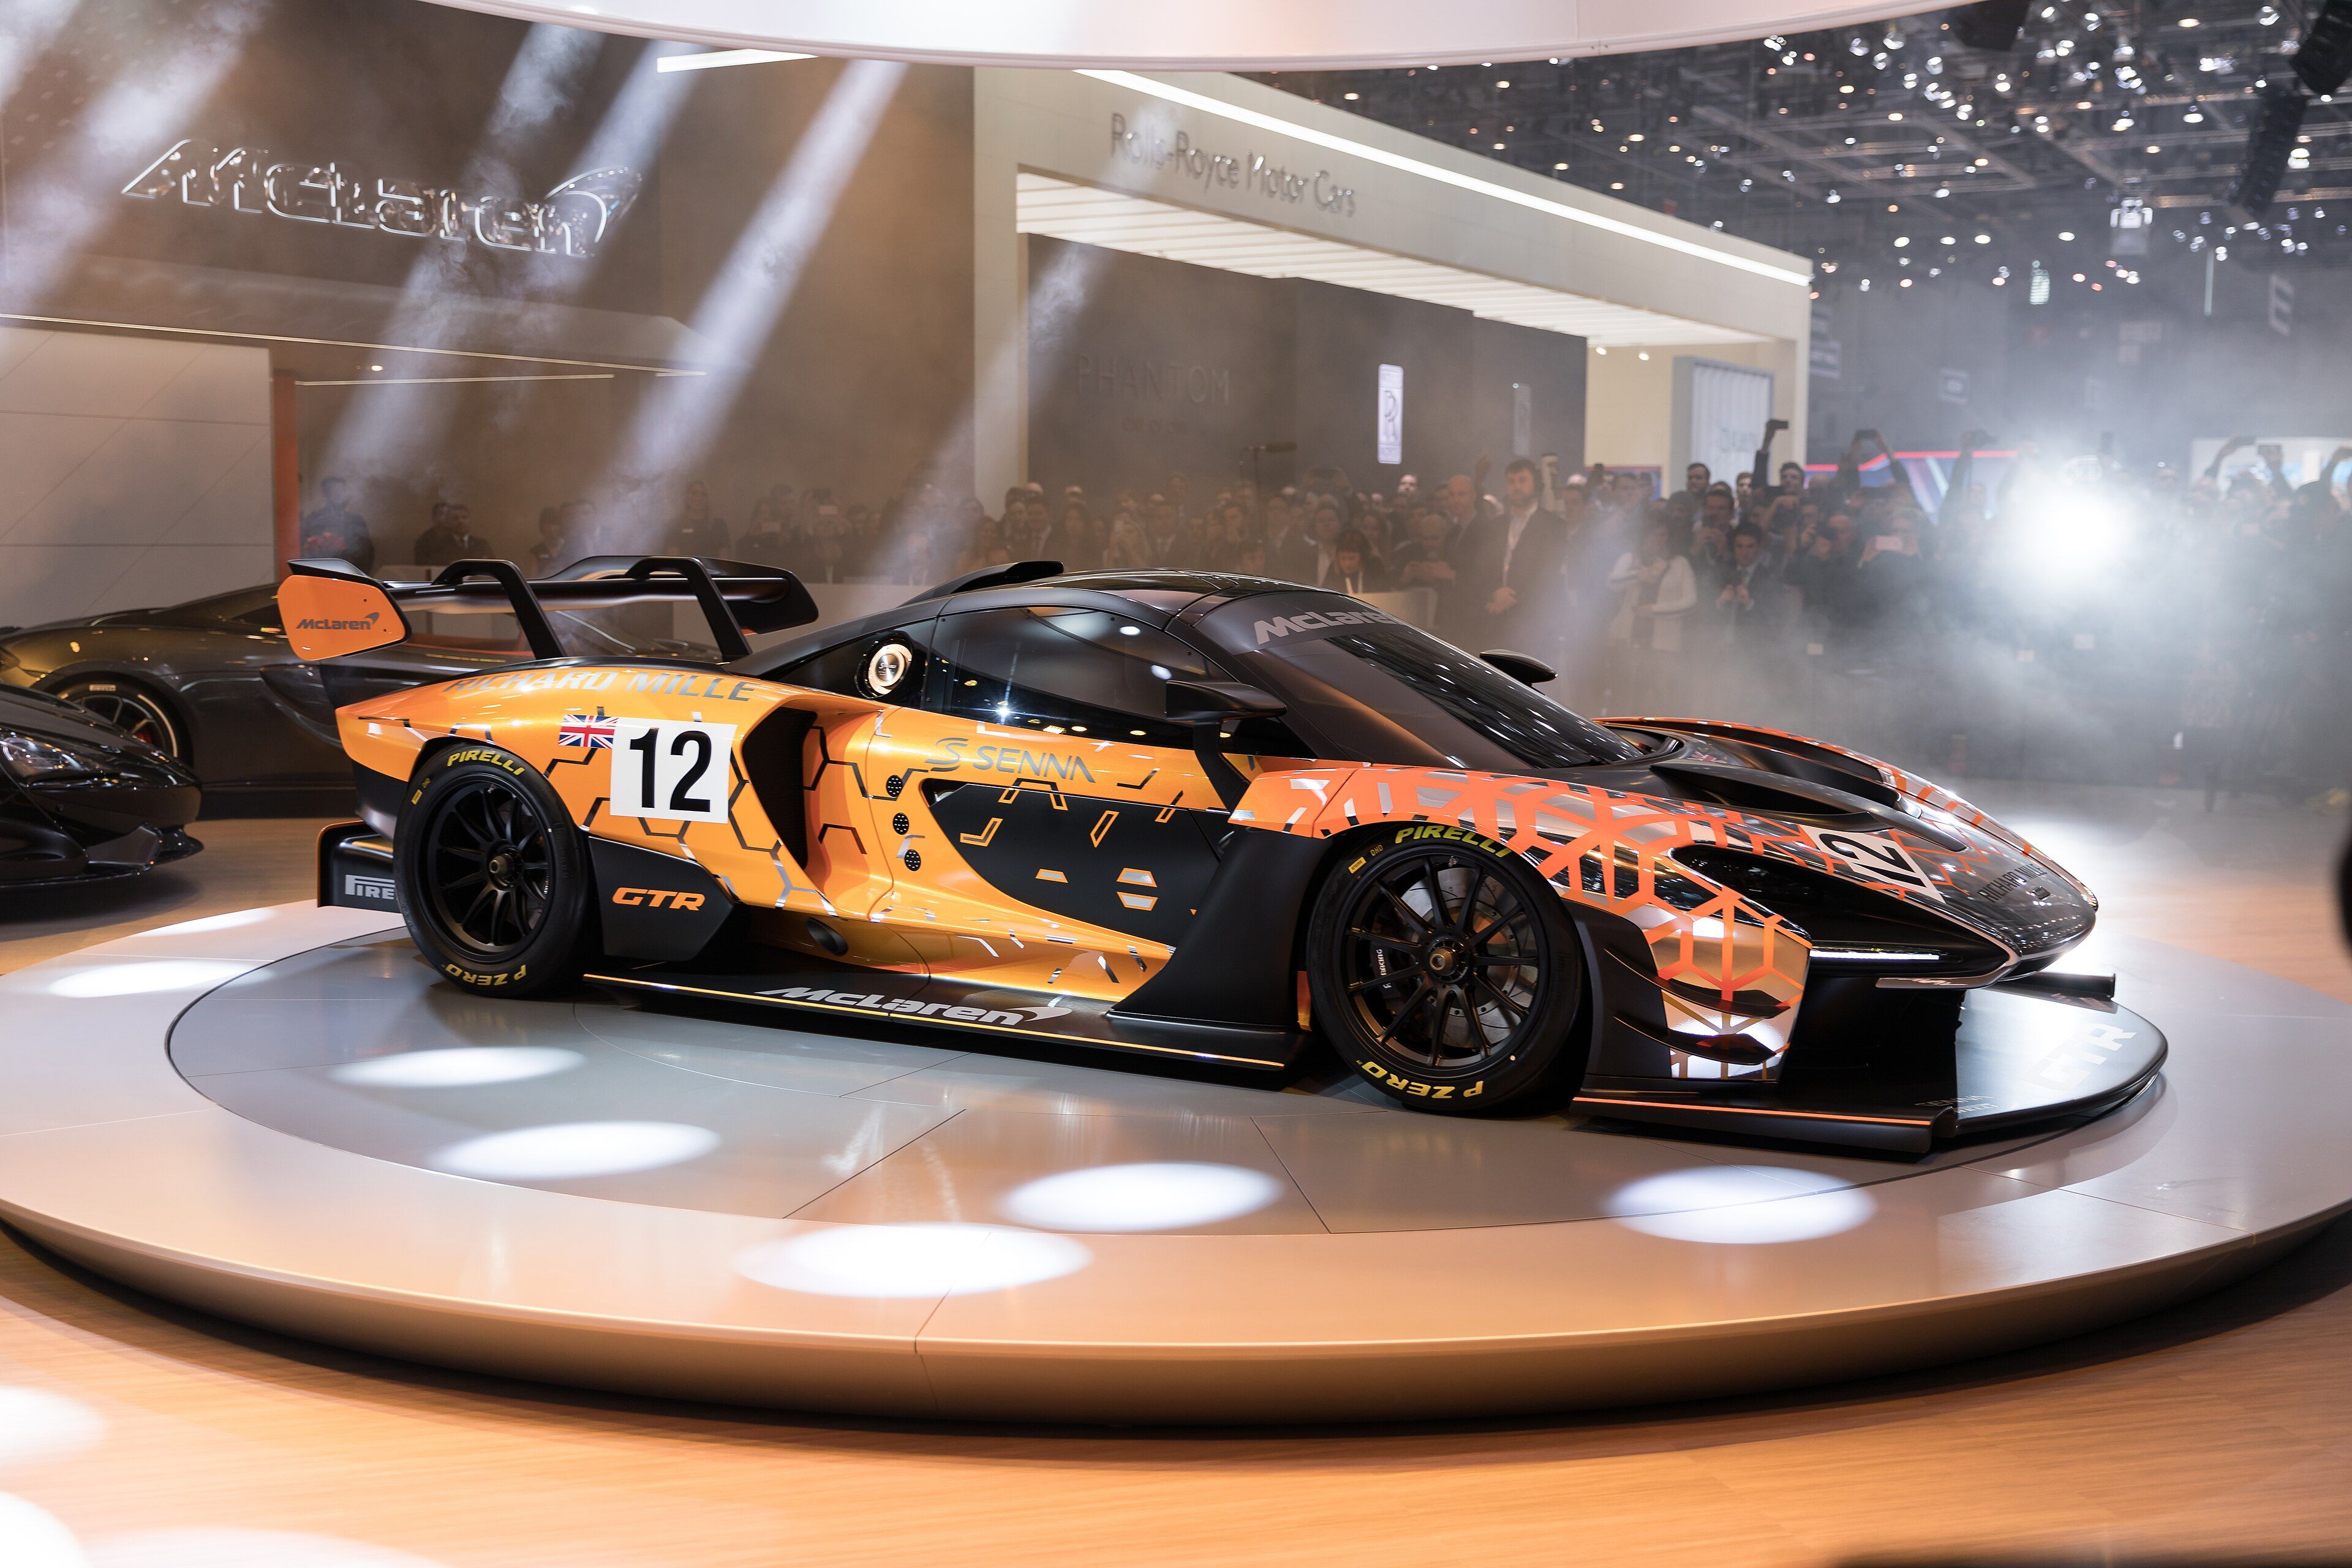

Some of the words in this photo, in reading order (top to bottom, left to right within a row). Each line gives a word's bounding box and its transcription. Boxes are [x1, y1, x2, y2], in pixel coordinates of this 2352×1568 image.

[1110, 111, 1240, 193] Rolls-Royce
[1246, 150, 1308, 203] Motor
[1314, 169, 1356, 218] Cars
[122, 138, 608, 258] McLaren
[1074, 352, 1230, 407] PHANTOM
[295, 618, 371, 630] McLaren
[1253, 611, 1399, 645] McLare
[442, 670, 614, 693] RICHARD
[625, 672, 756, 702] MILLE
[447, 749, 526, 775] PIRELLI
[628, 728, 712, 813] 12
[973, 745, 1096, 783] SENNA
[1395, 824, 1514, 858] PIRELLI
[1819, 833, 1928, 888] 12
[344, 874, 396, 900] PIRE
[612, 886, 706, 911] GTR
[1976, 871, 2028, 903] RICHARD
[2014, 863, 2048, 880] MILLE
[445, 963, 508, 986] ZERO
[513, 963, 527, 981] P
[753, 986, 1027, 1027] McLaren
[2021, 1023, 2138, 1091] GTR
[1361, 1061, 1456, 1099] ZERO
[1463, 1080, 1485, 1098] P
